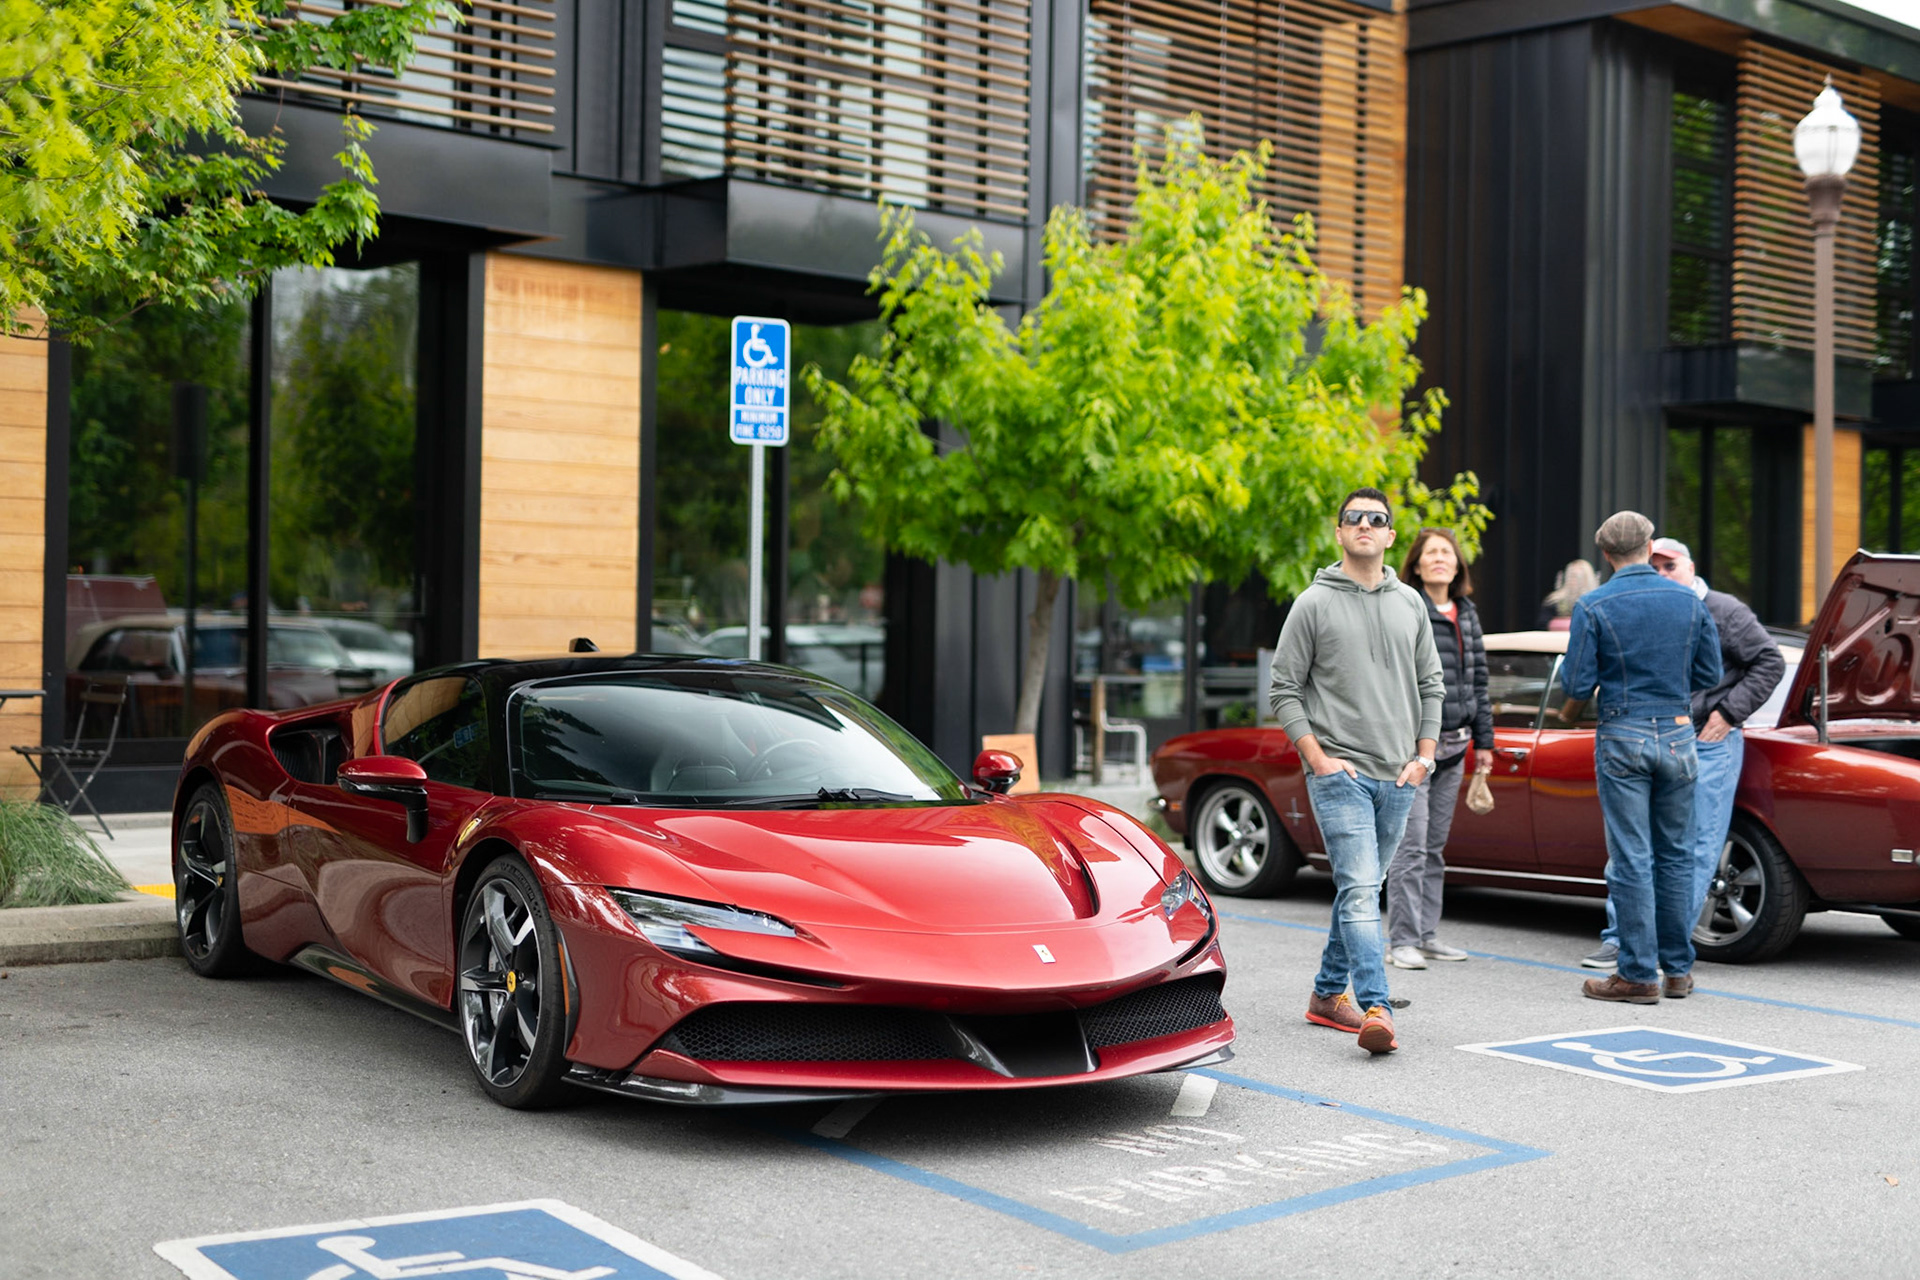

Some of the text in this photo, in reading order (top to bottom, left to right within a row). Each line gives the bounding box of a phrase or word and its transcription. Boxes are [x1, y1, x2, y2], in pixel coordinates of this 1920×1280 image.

[736, 366, 785, 388] PARKING
[744, 386, 776, 405] ONLY
[741, 411, 778, 424] MINIMUM
[736, 423, 755, 438] FINE
[1088, 1125, 1244, 1157] NO
[1049, 1133, 1450, 1216] PARKING
